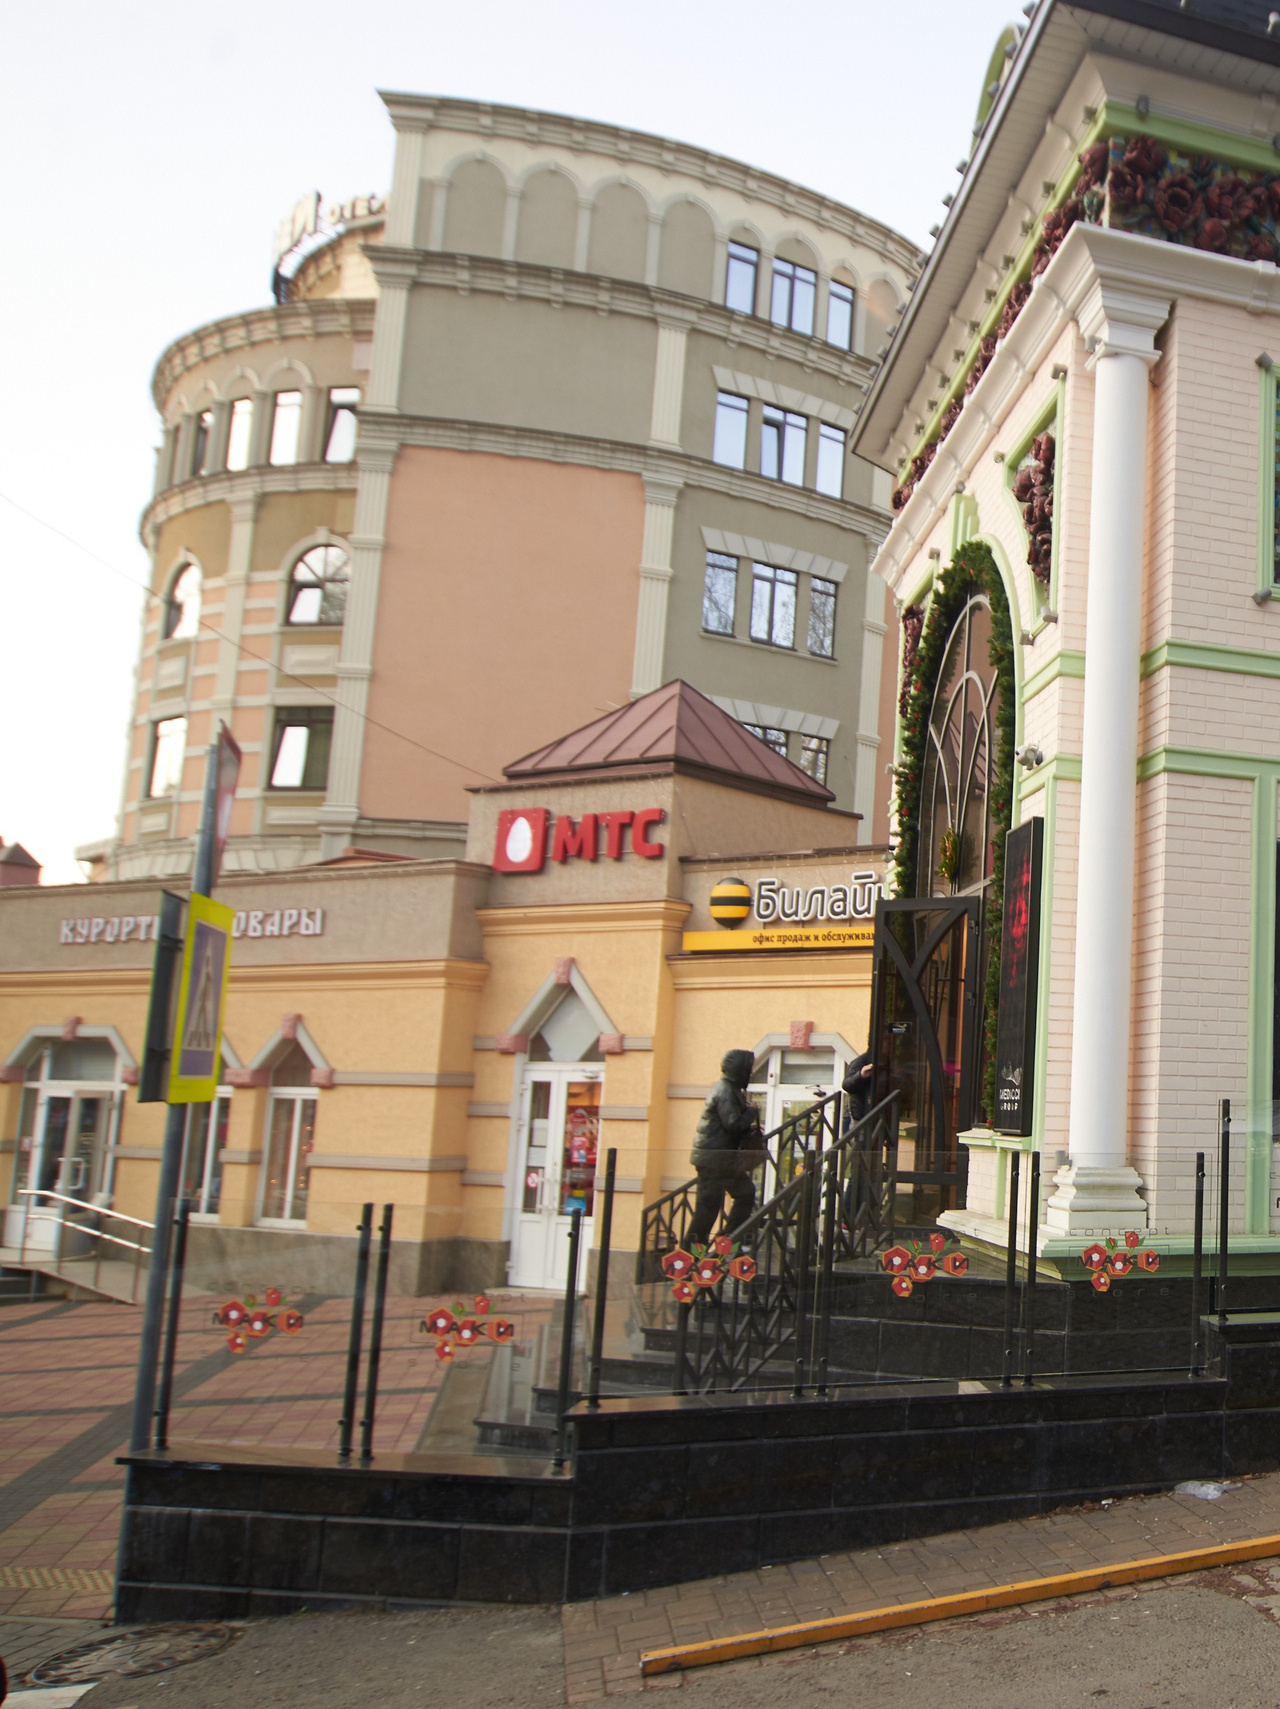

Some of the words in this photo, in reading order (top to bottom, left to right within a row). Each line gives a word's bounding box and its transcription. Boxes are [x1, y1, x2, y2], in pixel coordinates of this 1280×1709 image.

[552, 808, 664, 862] МТС
[232, 908, 323, 938] ОВАРЫ
[753, 933, 774, 944] офис
[777, 932, 811, 944] продаж
[813, 933, 820, 942] и
[876, 1257, 970, 1272] МАКИ
[1076, 1254, 1161, 1268] МАКИ
[418, 1320, 515, 1337] МАКИ
